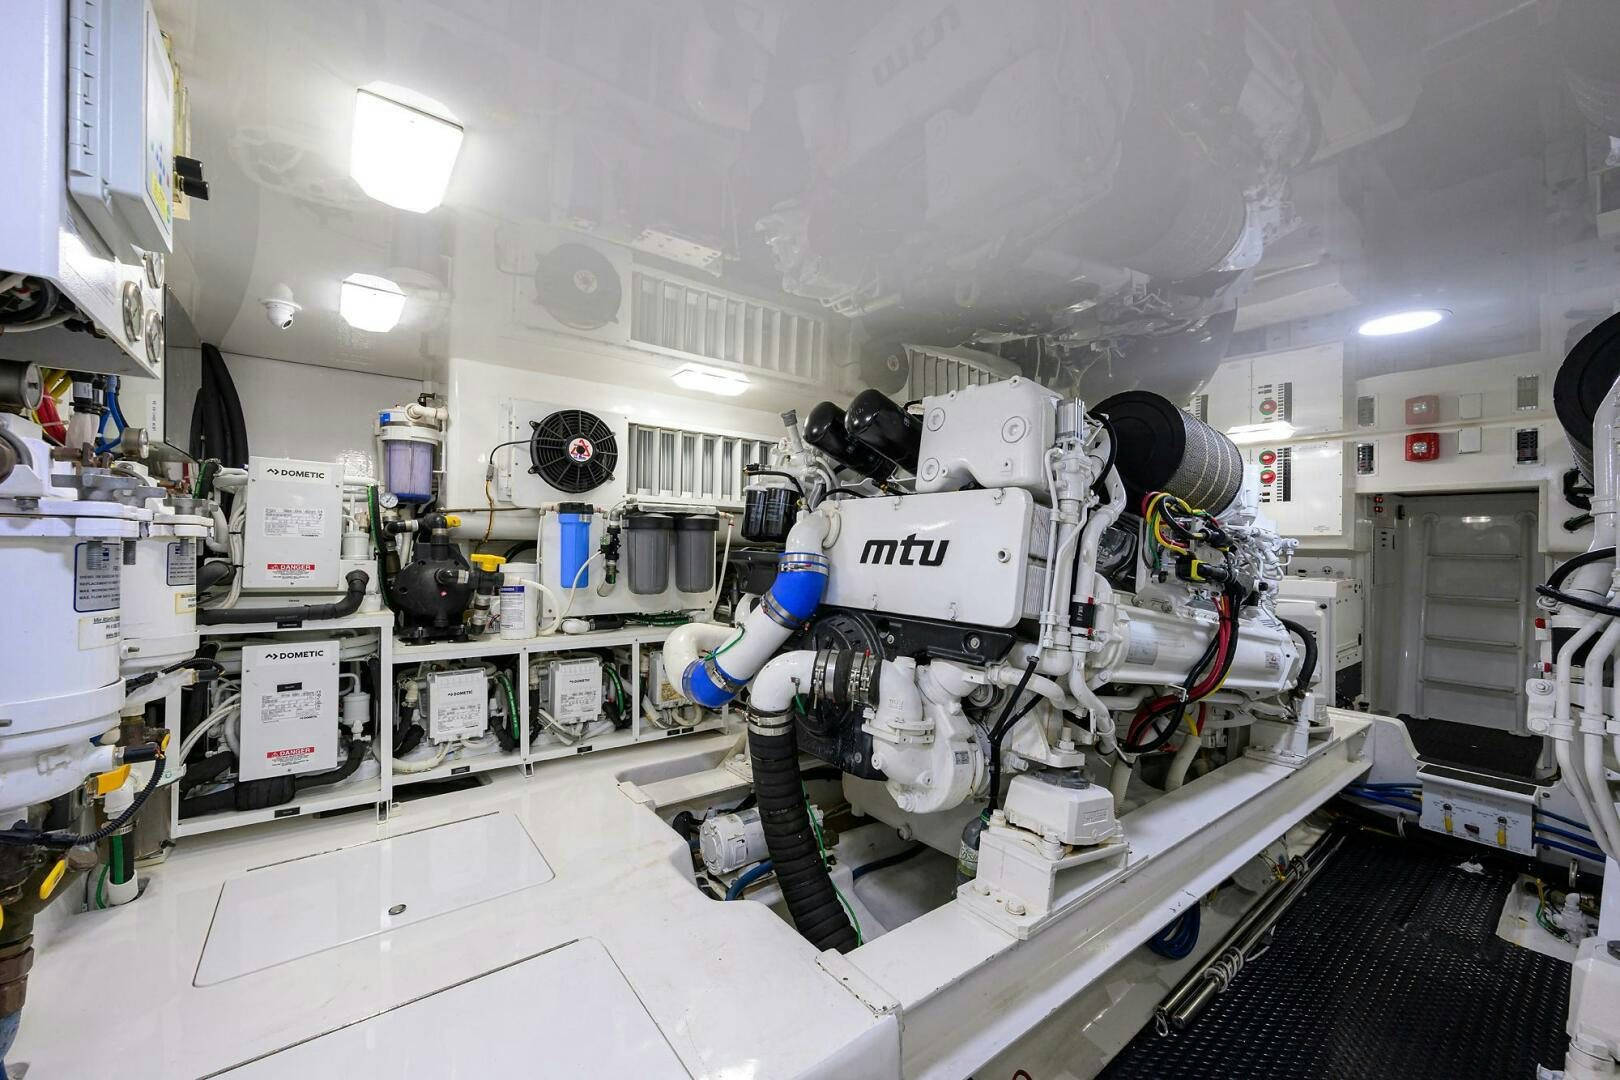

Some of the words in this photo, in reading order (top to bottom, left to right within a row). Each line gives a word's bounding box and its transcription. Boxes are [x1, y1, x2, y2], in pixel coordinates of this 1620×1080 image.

[281, 469, 325, 479] DOMETIC
[859, 533, 950, 566] mtu
[279, 650, 324, 659] DOMETIC
[280, 748, 311, 756] DANGER
